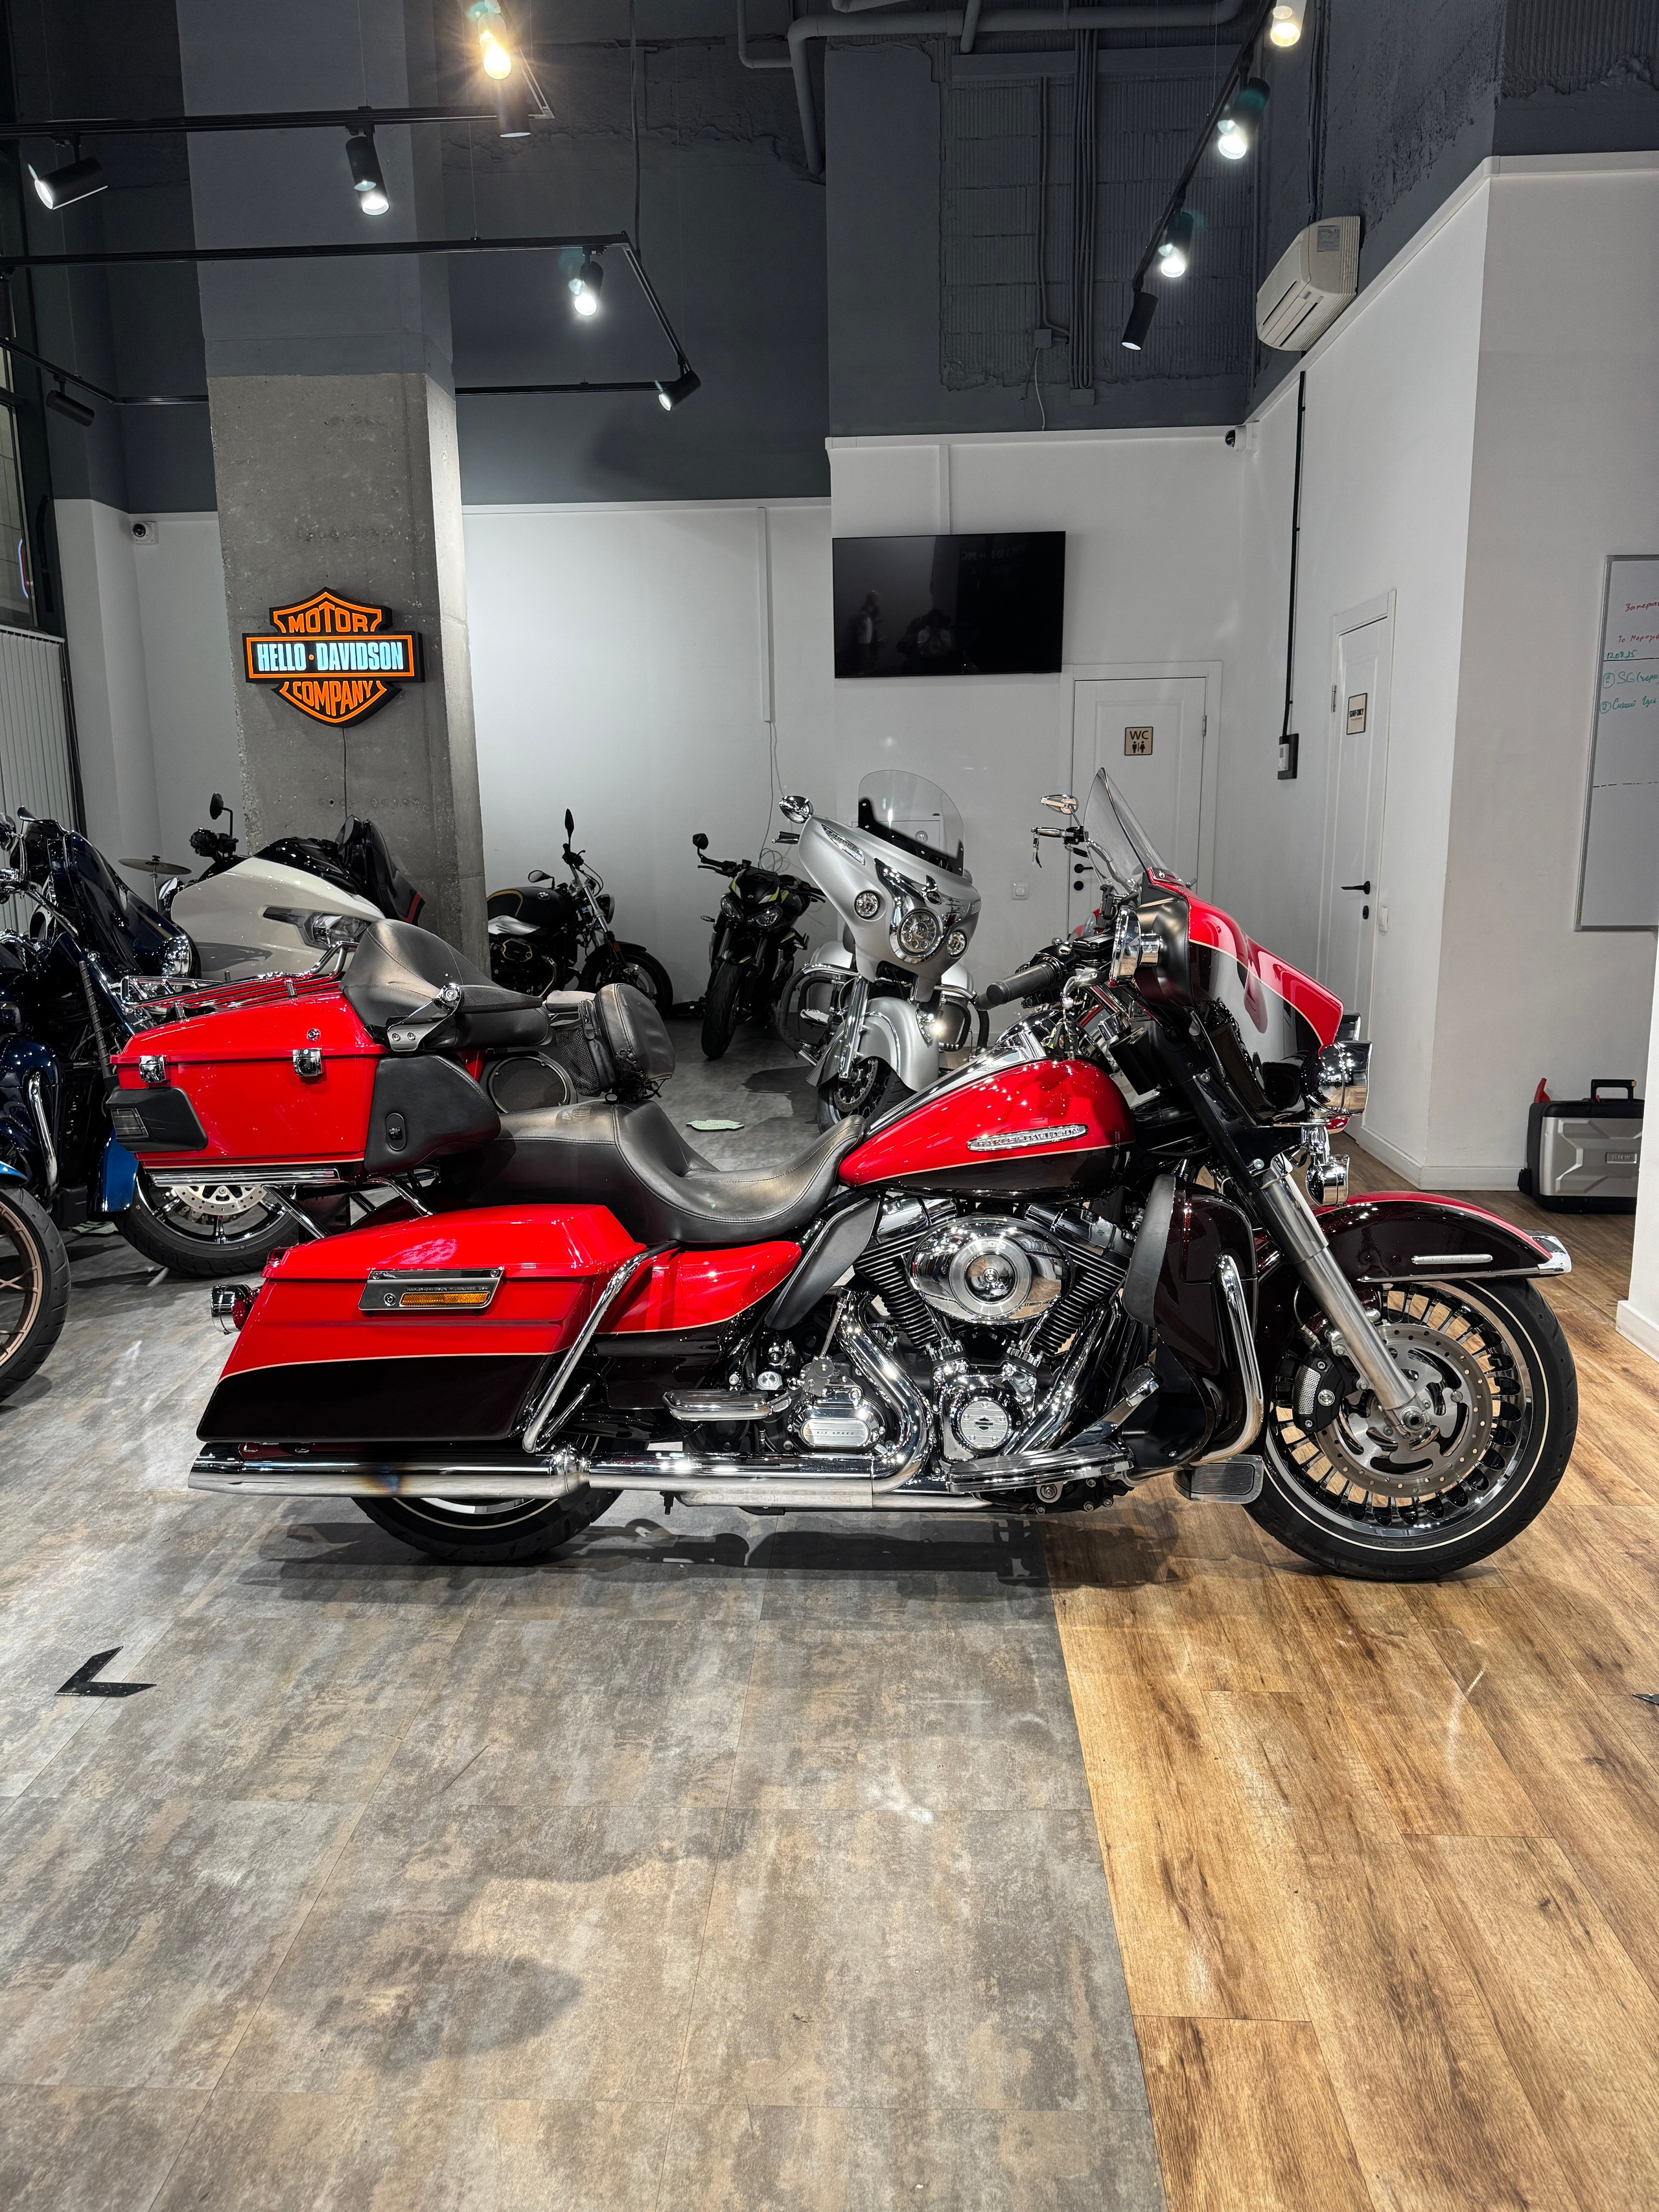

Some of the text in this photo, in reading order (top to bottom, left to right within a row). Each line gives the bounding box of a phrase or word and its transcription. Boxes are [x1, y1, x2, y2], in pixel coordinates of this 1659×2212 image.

[288, 600, 368, 633] MOTOR
[257, 642, 404, 671] HELLO DAVIDSON
[292, 680, 373, 717] COMPANY
[1130, 730, 1149, 740] WC
[977, 1127, 1081, 1147] HARLEY-DAVIDSON
